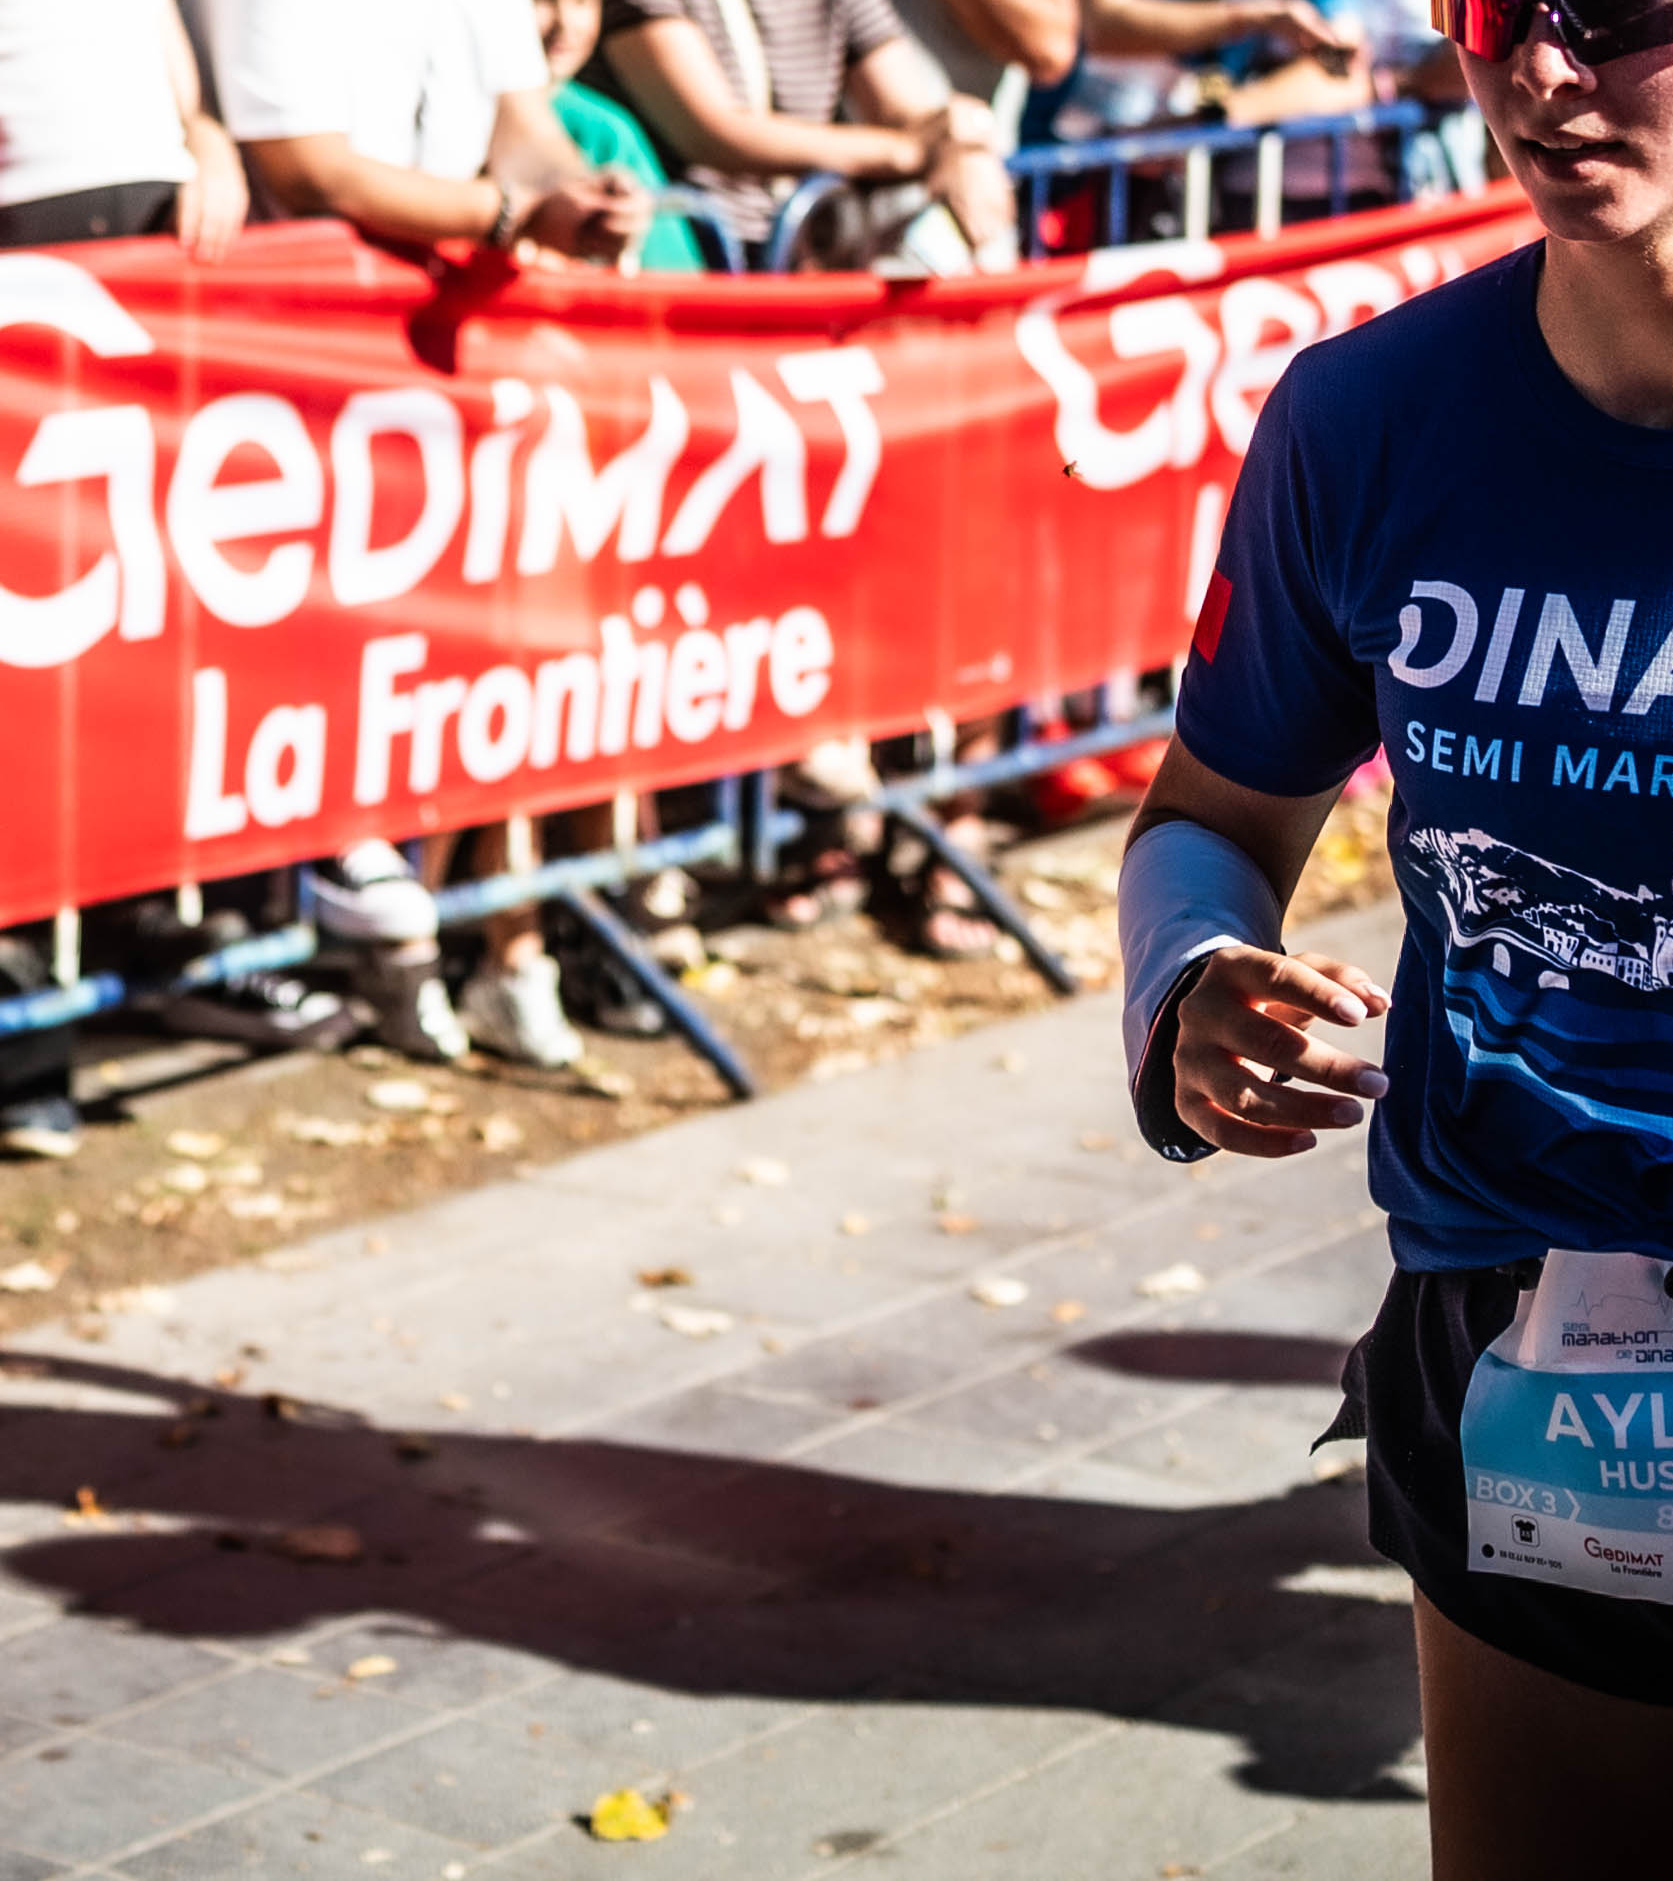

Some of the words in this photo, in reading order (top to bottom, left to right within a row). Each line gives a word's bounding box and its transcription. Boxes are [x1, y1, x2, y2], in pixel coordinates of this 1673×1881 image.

[184, 667, 328, 843] La
[353, 582, 835, 808] Frontière
[1406, 720, 1522, 783] SEMI
[1475, 1475, 1536, 1512] BOX
[1541, 1490, 1558, 1515] 3
